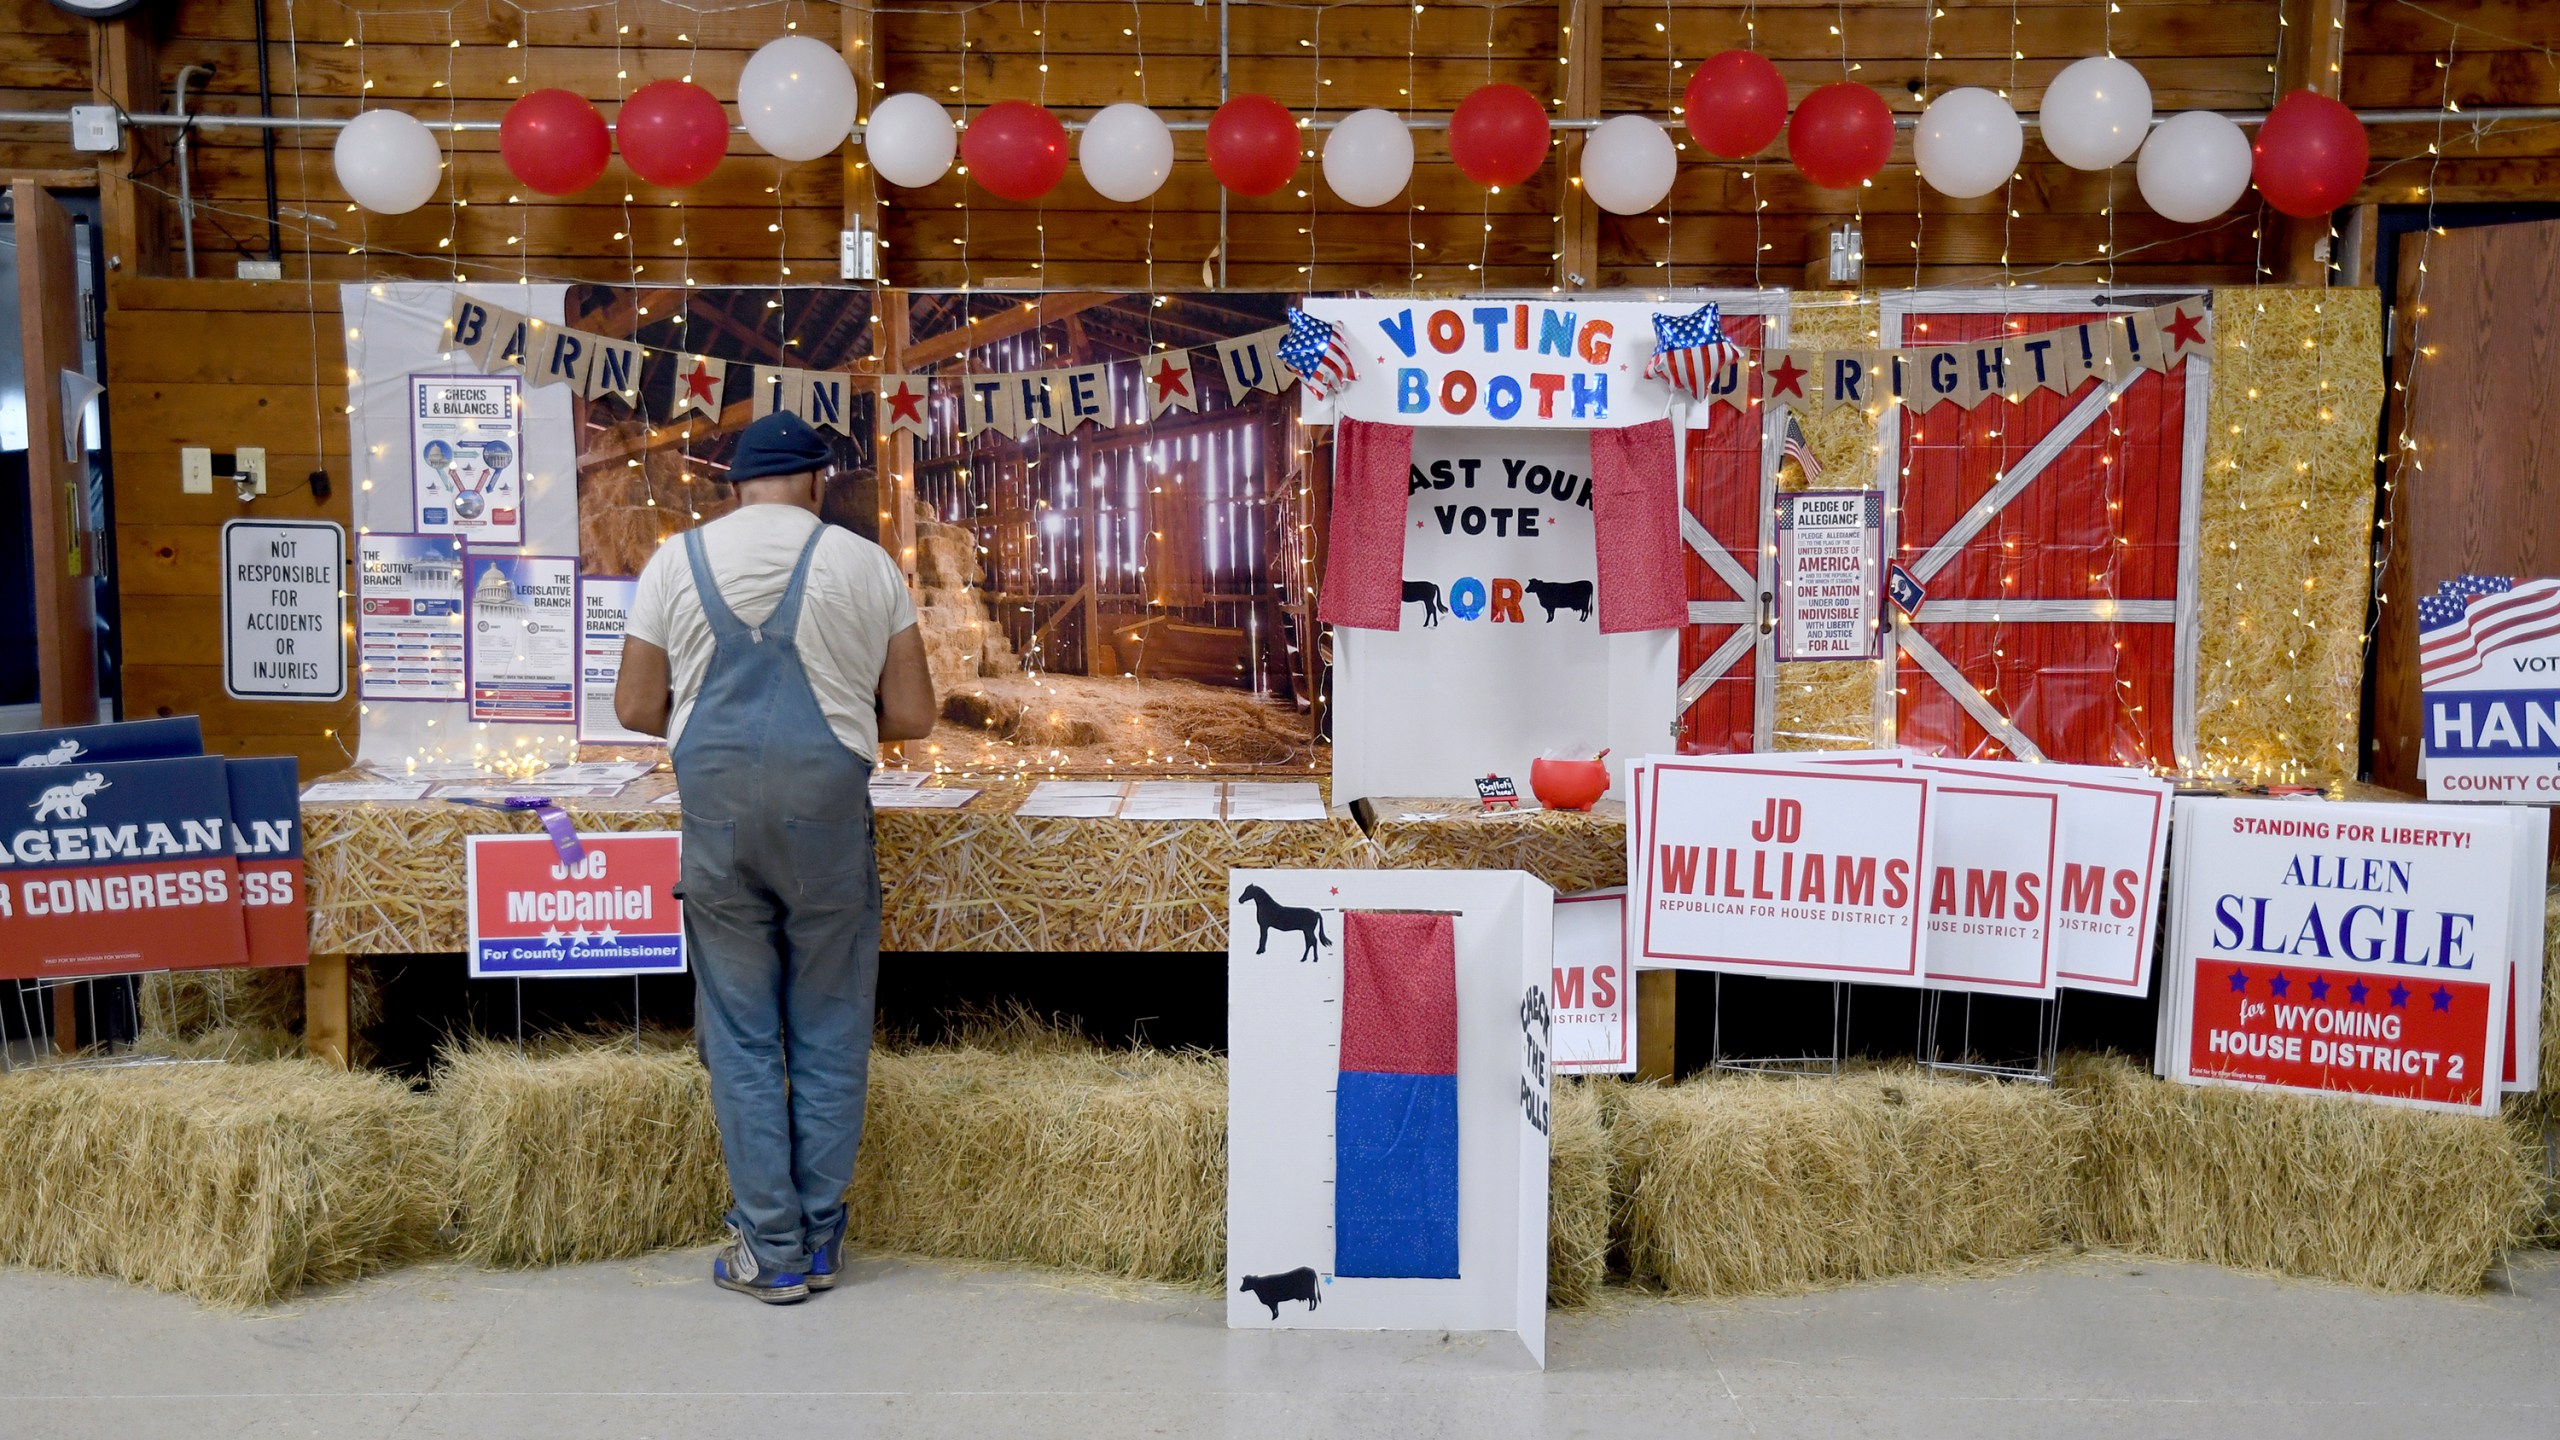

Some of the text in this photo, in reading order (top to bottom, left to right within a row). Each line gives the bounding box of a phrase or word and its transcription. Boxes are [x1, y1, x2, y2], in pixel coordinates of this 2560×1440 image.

[1378, 304, 1614, 365] VOTING
[455, 302, 632, 392] BARN
[772, 374, 842, 424] IN
[974, 373, 1101, 424] THE
[1834, 315, 2140, 401] RIGHT!!
[445, 389, 487, 401] CHECKS
[1398, 368, 1608, 421] BOOTH
[433, 402, 499, 415] & BALANCES
[1802, 500, 1855, 513] PLEDGE OF
[1434, 505, 1540, 537] VOTE
[1798, 513, 1859, 526] ALLEGIANCE
[1826, 531, 1860, 539] ALLEGIANCE
[271, 541, 297, 558] NOT
[363, 550, 380, 560] THE
[1797, 546, 1860, 555] UNITED STATES OF
[1798, 556, 1860, 572] AMERICA
[238, 564, 331, 584] RESPONSIBLE
[363, 575, 402, 586] BRANCH
[554, 574, 571, 584] THE
[272, 590, 298, 607] FOR
[516, 585, 571, 596] LEGISLATIVE
[1798, 584, 1860, 598] ONE NATION
[534, 597, 572, 608] BRANCH
[586, 596, 604, 607] THE
[1450, 576, 1525, 624] OR
[1808, 598, 1850, 607] UNDER GOD
[247, 613, 323, 632] ACCIDENTS
[586, 608, 628, 620] JUDICIAL
[1798, 608, 1859, 620] INDIVISIBLE
[586, 620, 625, 631] BRANCH
[1806, 620, 1855, 630] WITH LIBERTY
[1807, 630, 1852, 638] AND JUSTICE
[276, 638, 295, 655] OR
[1808, 640, 1850, 651] FOR ALL
[254, 661, 318, 680] INJURIES
[2433, 701, 2560, 748] HAN
[1478, 780, 1512, 793] Ballots
[2443, 775, 2530, 791] COUNTY
[1751, 798, 1802, 844] JD
[2232, 816, 2472, 849] STANDING FOR LIBERTY!
[1660, 844, 1910, 909] WILLIAMS
[2281, 853, 2414, 895] ALLEN
[23, 868, 229, 916] CONGRESS
[238, 870, 294, 906] SS
[508, 885, 653, 923] McDaniel
[1660, 900, 1909, 926] REPUBLICAN FOR HOUSE DISTRICT 2
[1962, 924, 2026, 939] DISTRICT
[2032, 928, 2040, 940] 2
[2127, 926, 2135, 937] 2
[2212, 893, 2476, 971] SLAGLE
[483, 945, 679, 962] For County Commissioner
[1520, 985, 1550, 1047] CHECK
[1611, 1012, 1618, 1022] 2
[2239, 998, 2401, 1040] for WYOMING
[1526, 1031, 1545, 1088] THE
[2209, 1029, 2464, 1081] HOUSE DISTRICT 2
[1520, 1074, 1548, 1137] POLLS
